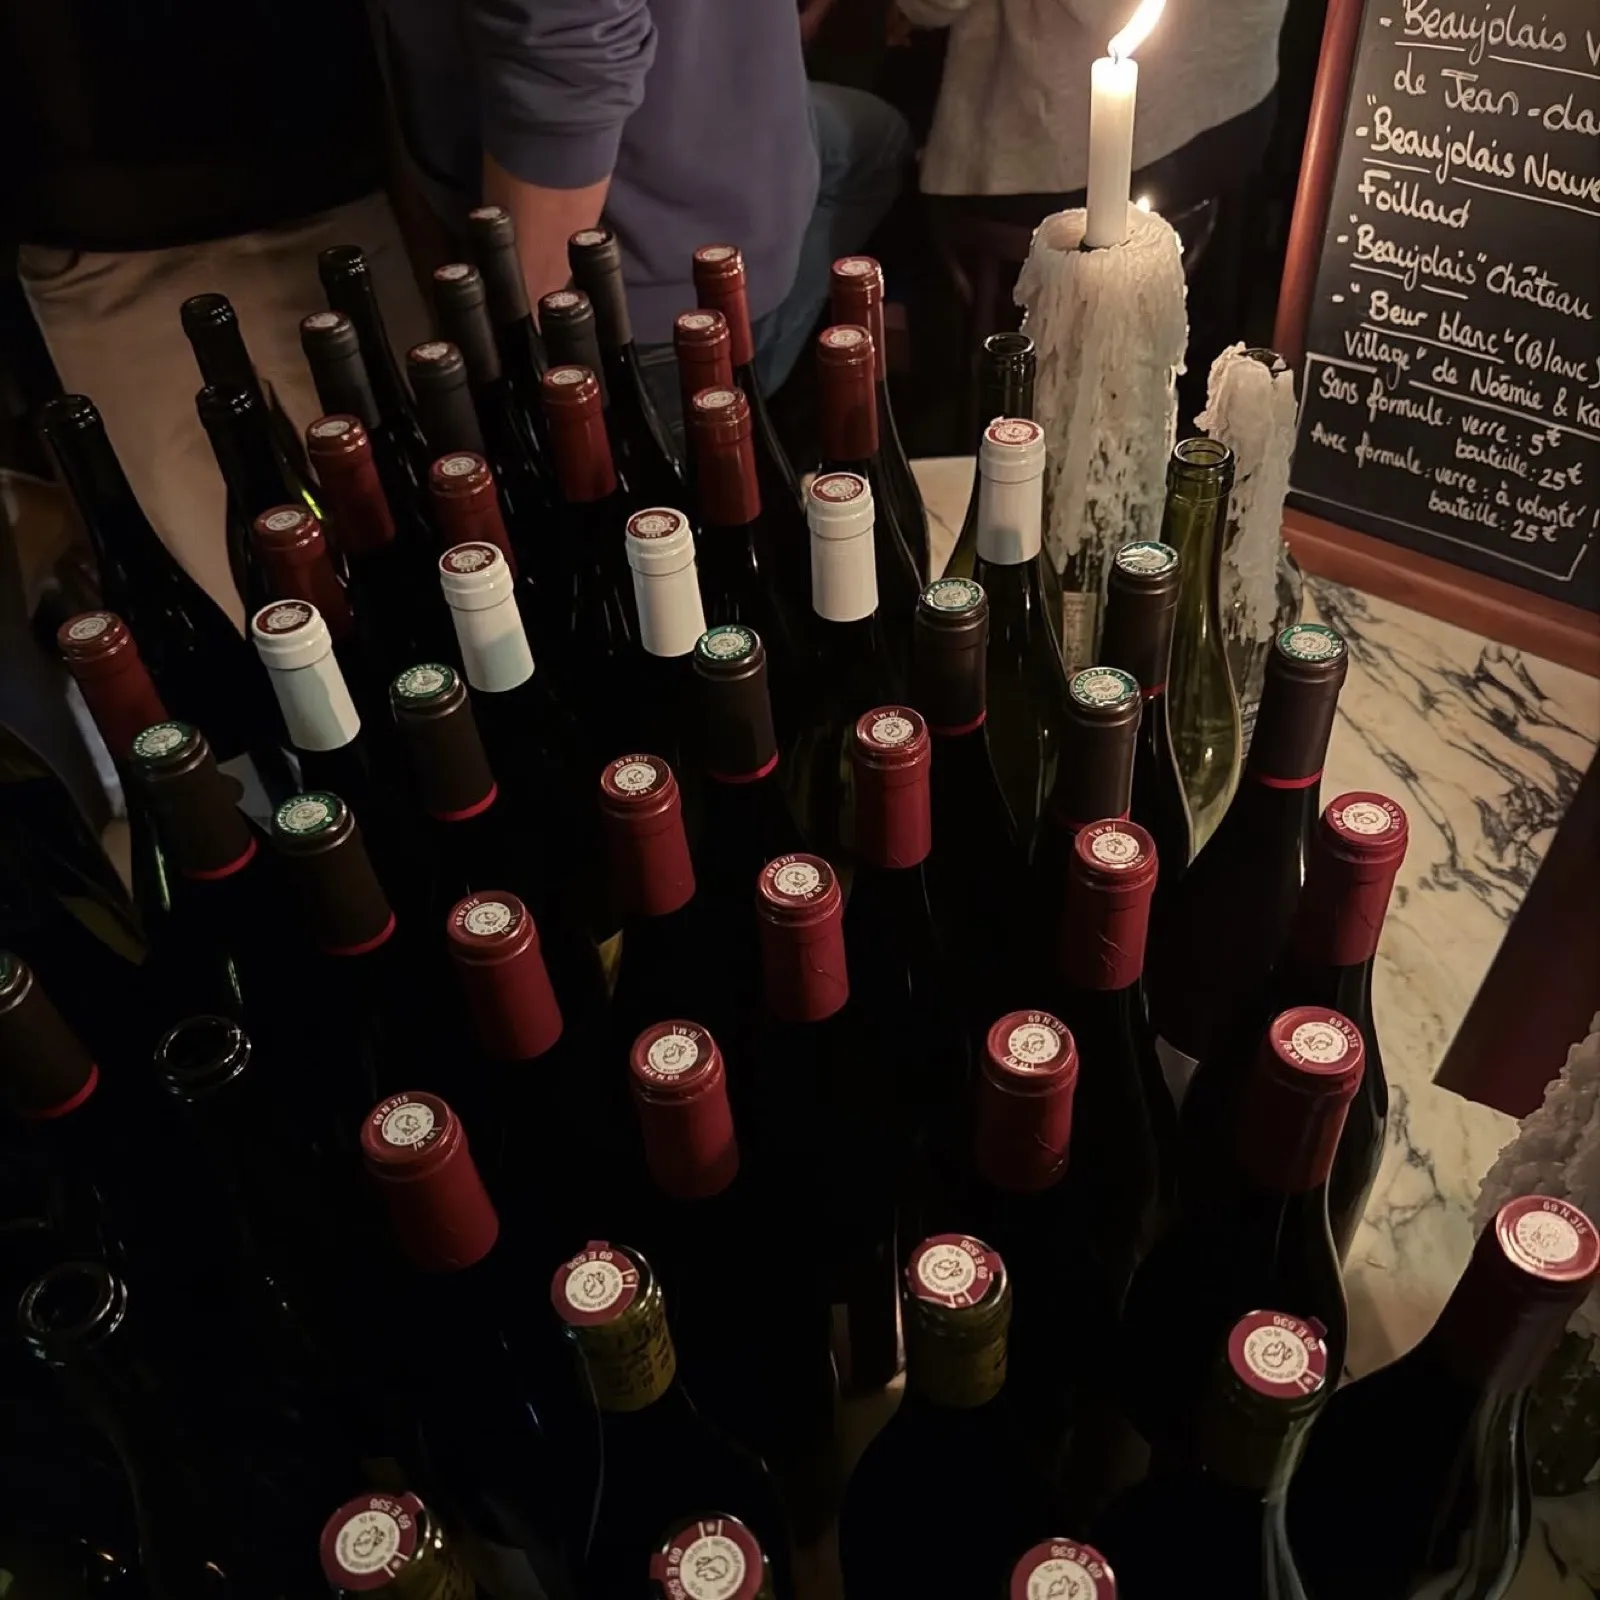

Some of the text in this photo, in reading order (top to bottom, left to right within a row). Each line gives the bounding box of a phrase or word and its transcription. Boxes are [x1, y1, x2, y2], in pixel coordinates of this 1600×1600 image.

[1394, 51, 1426, 95] de
[1486, 262, 1593, 320] Château
[1319, 366, 1359, 405] Sans
[1432, 357, 1458, 384] de
[1553, 387, 1568, 417] &
[1310, 421, 1347, 453] Avec
[1495, 480, 1511, 507] à
